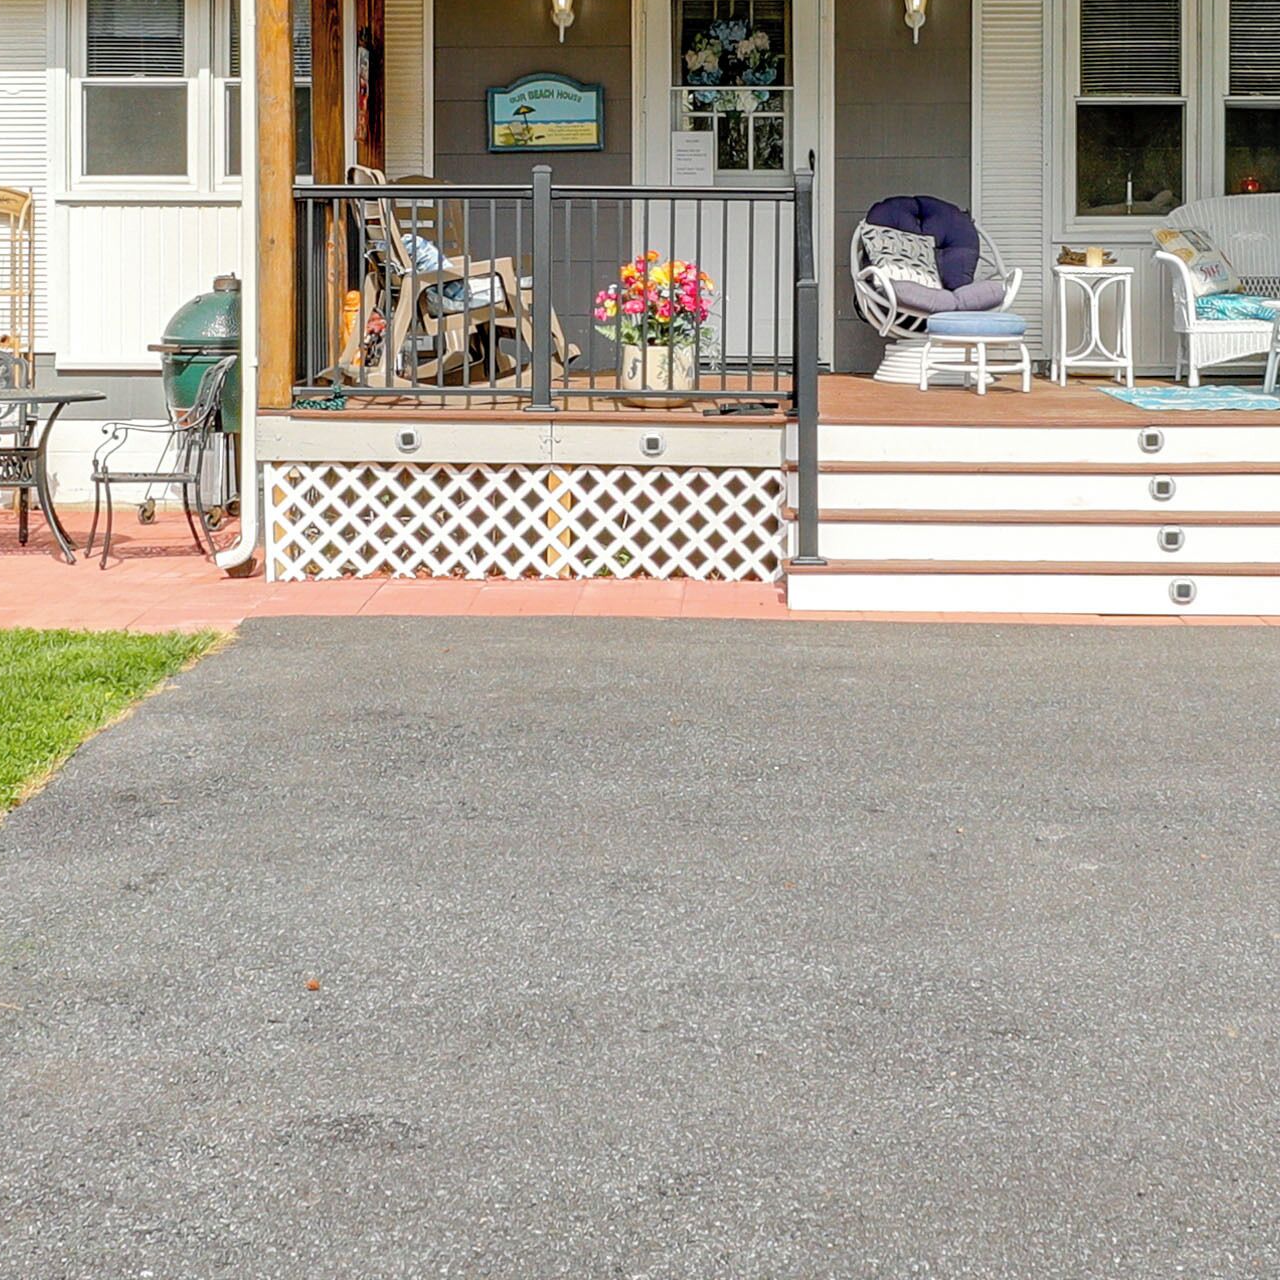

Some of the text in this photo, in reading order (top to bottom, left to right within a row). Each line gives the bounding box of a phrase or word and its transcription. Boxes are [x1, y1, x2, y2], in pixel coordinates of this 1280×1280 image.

[509, 88, 582, 104] OUR BEACH HOUSE
